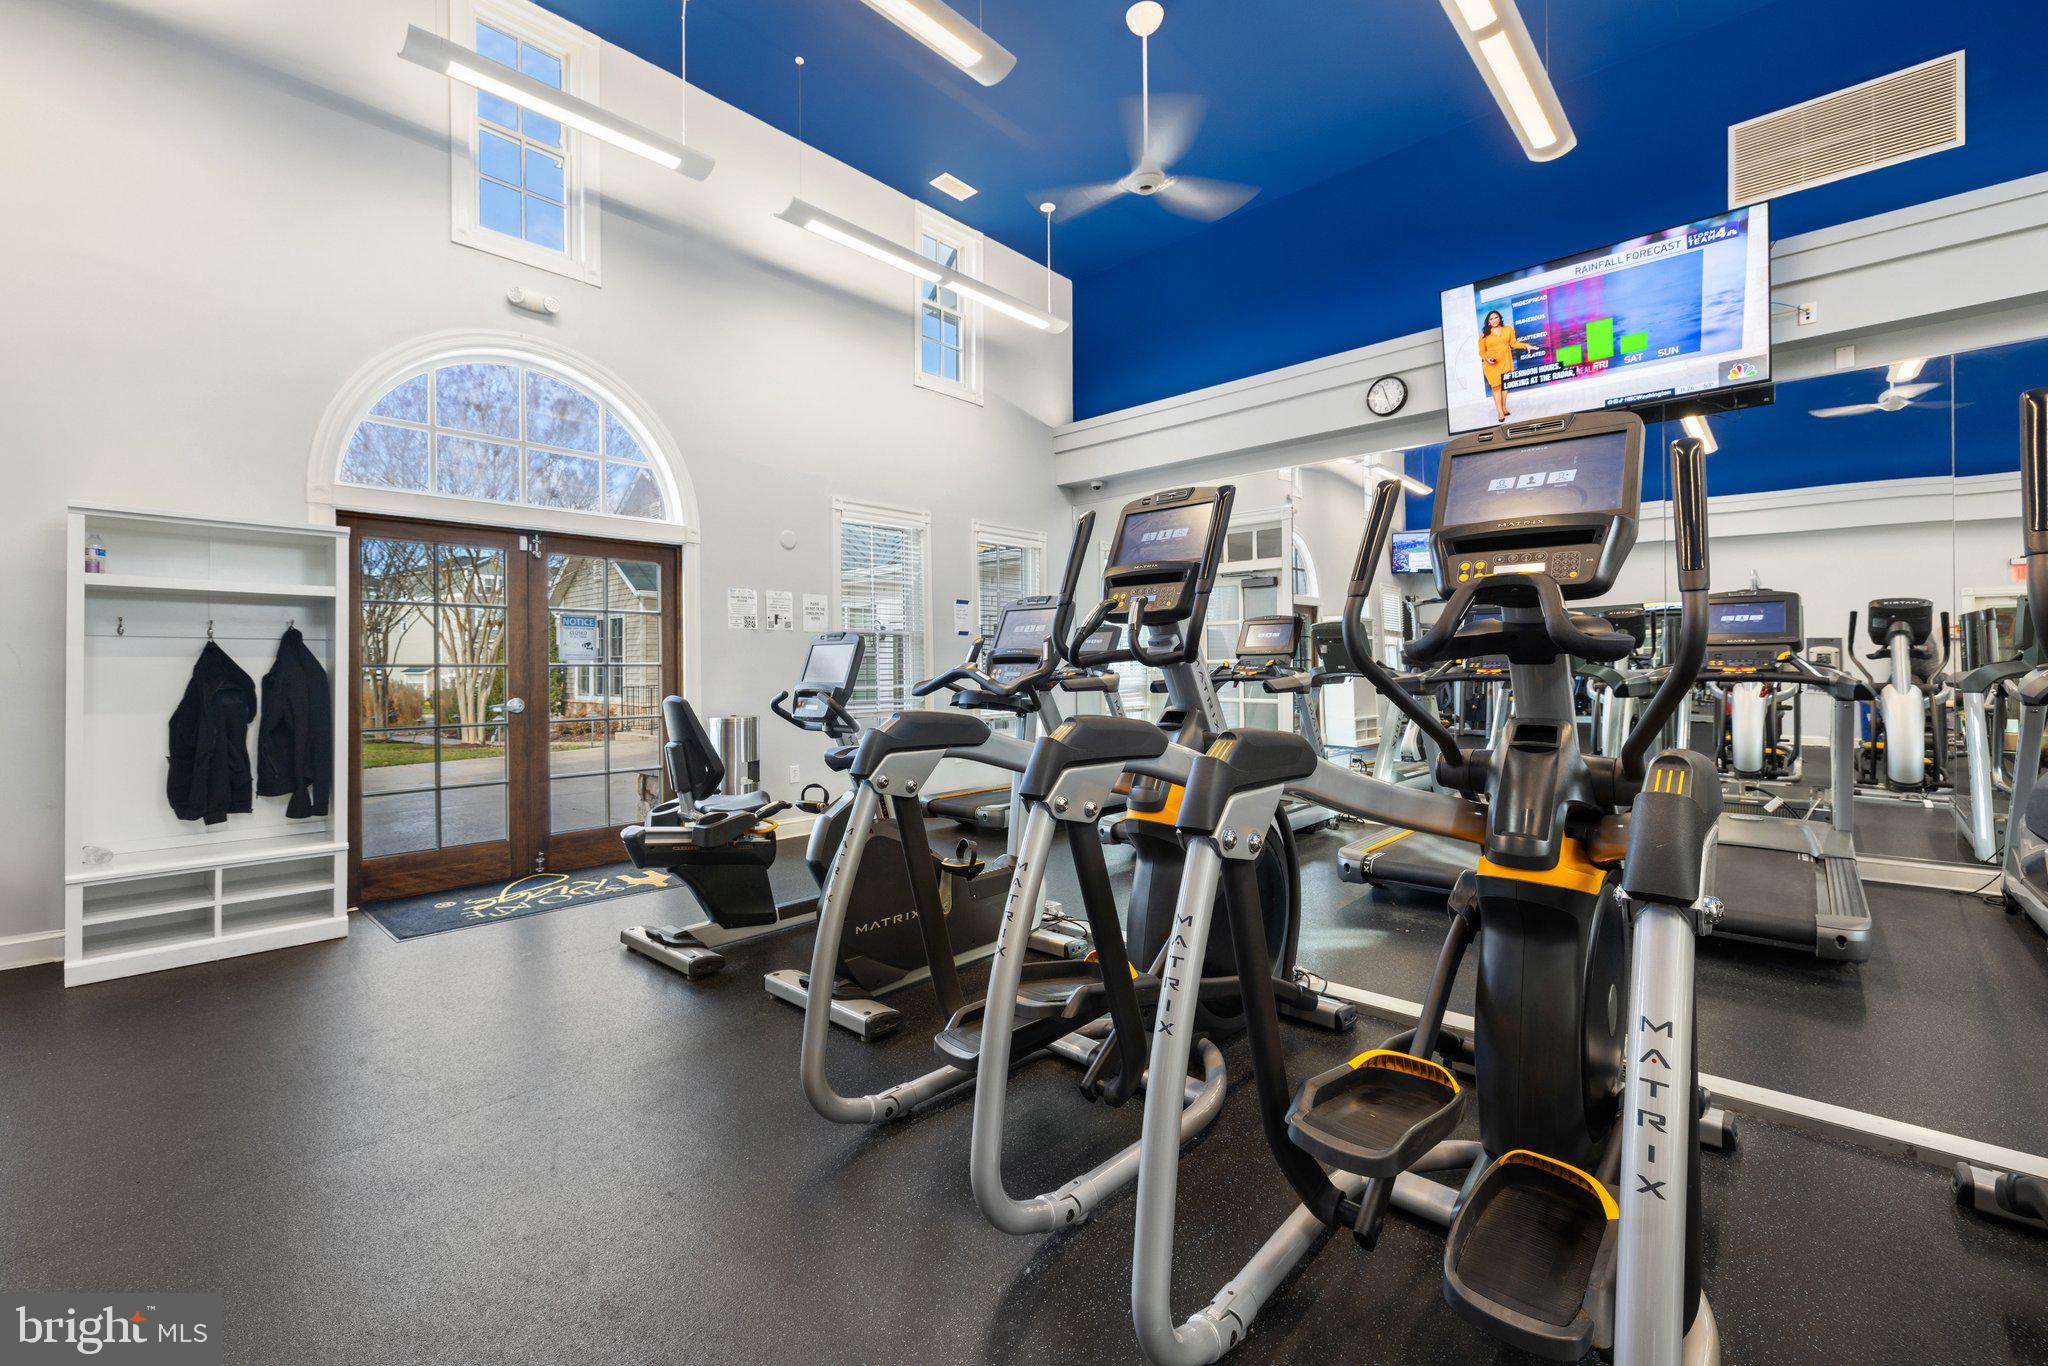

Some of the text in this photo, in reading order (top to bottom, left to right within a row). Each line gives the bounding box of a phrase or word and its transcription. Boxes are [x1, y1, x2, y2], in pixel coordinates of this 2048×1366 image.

[1688, 226, 1727, 240] STORM 4
[1688, 233, 1716, 247] TEAM
[1575, 240, 1682, 276] RAINFALL FORECAST
[1512, 294, 1548, 308] WIDESPREAD
[1515, 313, 1546, 325] NUMEROUS
[1517, 331, 1548, 342] SCATTERED
[1520, 350, 1546, 360] ISOLATED
[1624, 352, 1644, 364] SAT
[1657, 345, 1680, 357] SUN
[1593, 360, 1609, 370] FRI
[1503, 366, 1538, 380] AFTERNOON
[1503, 379, 1529, 390] LOOKING
[1530, 376, 1539, 385] AT
[1539, 374, 1552, 383] THE
[1497, 519, 1544, 528] MATRIX
[562, 617, 594, 626] NOTICE
[996, 862, 1028, 957] MATRIX
[855, 910, 920, 935] MATRIX
[1158, 914, 1193, 1036] MATRIX
[1636, 1015, 1674, 1201] MATRIX
